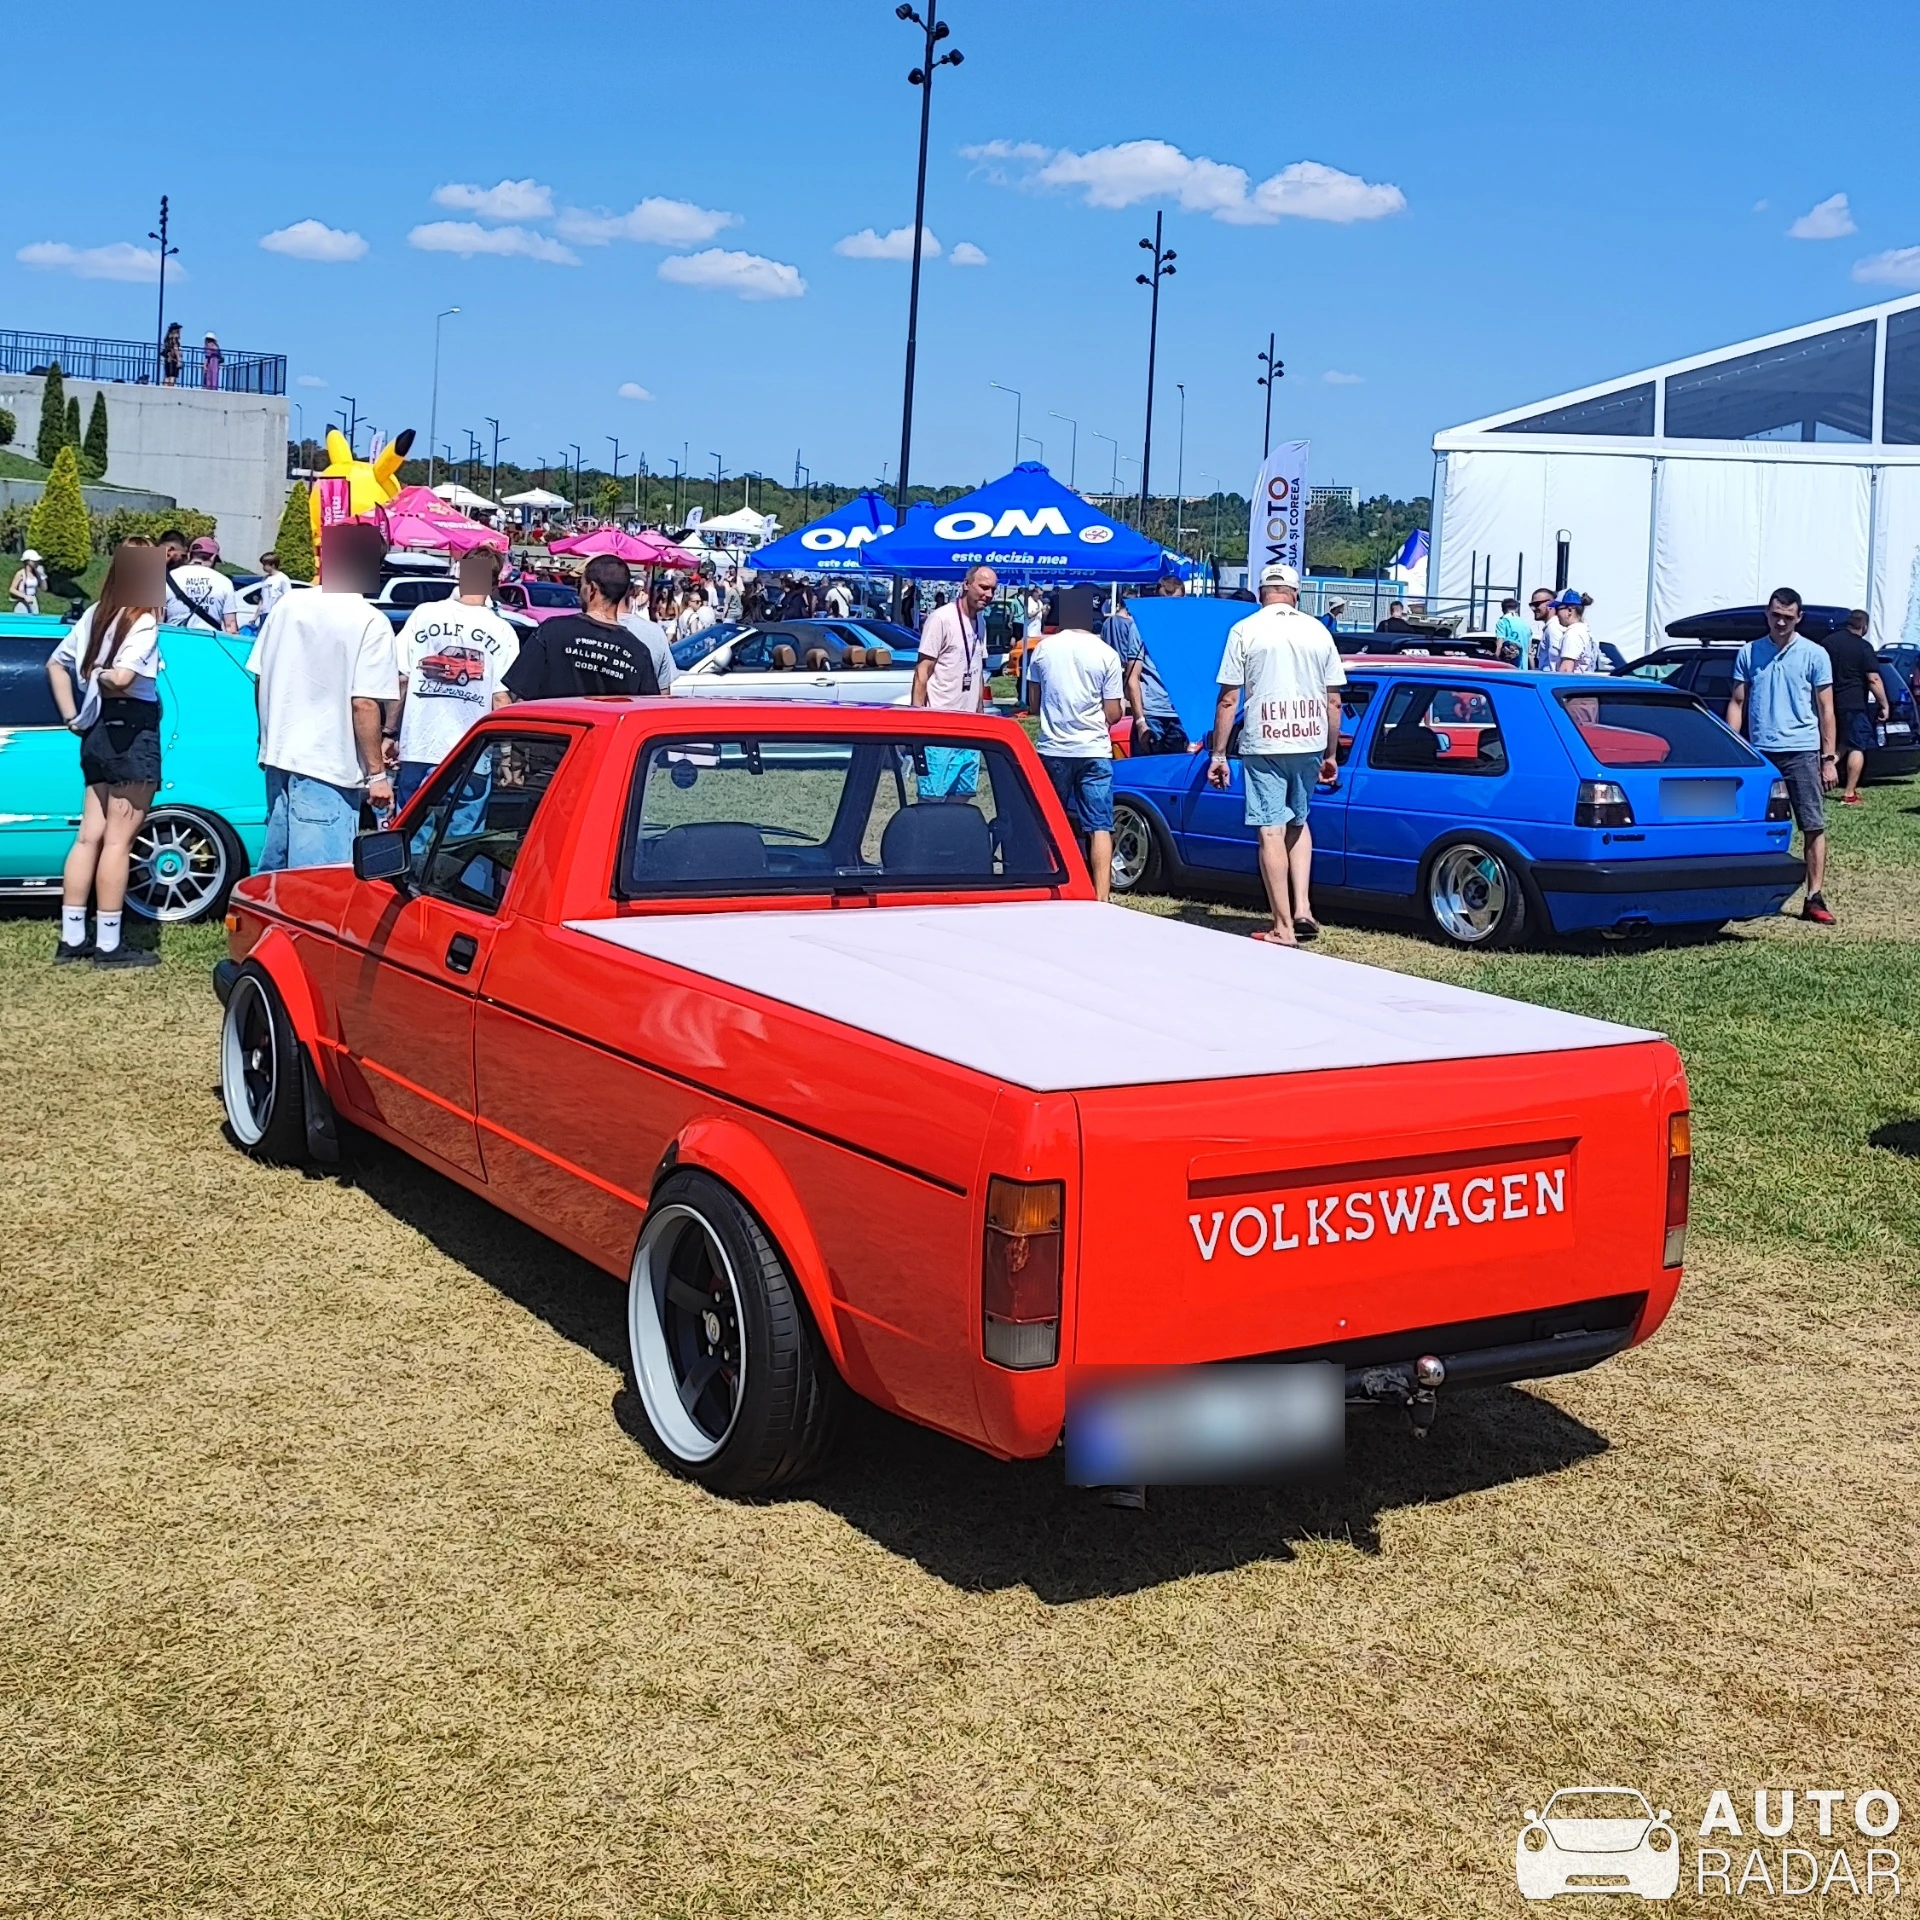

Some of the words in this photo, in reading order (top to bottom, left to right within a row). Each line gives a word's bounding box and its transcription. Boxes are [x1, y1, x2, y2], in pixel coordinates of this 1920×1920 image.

[1289, 477, 1300, 526] COREEA
[933, 506, 1072, 540] OM
[1265, 476, 1289, 566] MOTO
[951, 551, 982, 563] este
[985, 551, 1035, 565] decizia
[1037, 554, 1068, 566] mea
[414, 622, 464, 644] GOLF
[471, 628, 501, 656] GTI
[1261, 700, 1287, 721] NEW
[1188, 1168, 1566, 1261] VOLKSWAGEN
